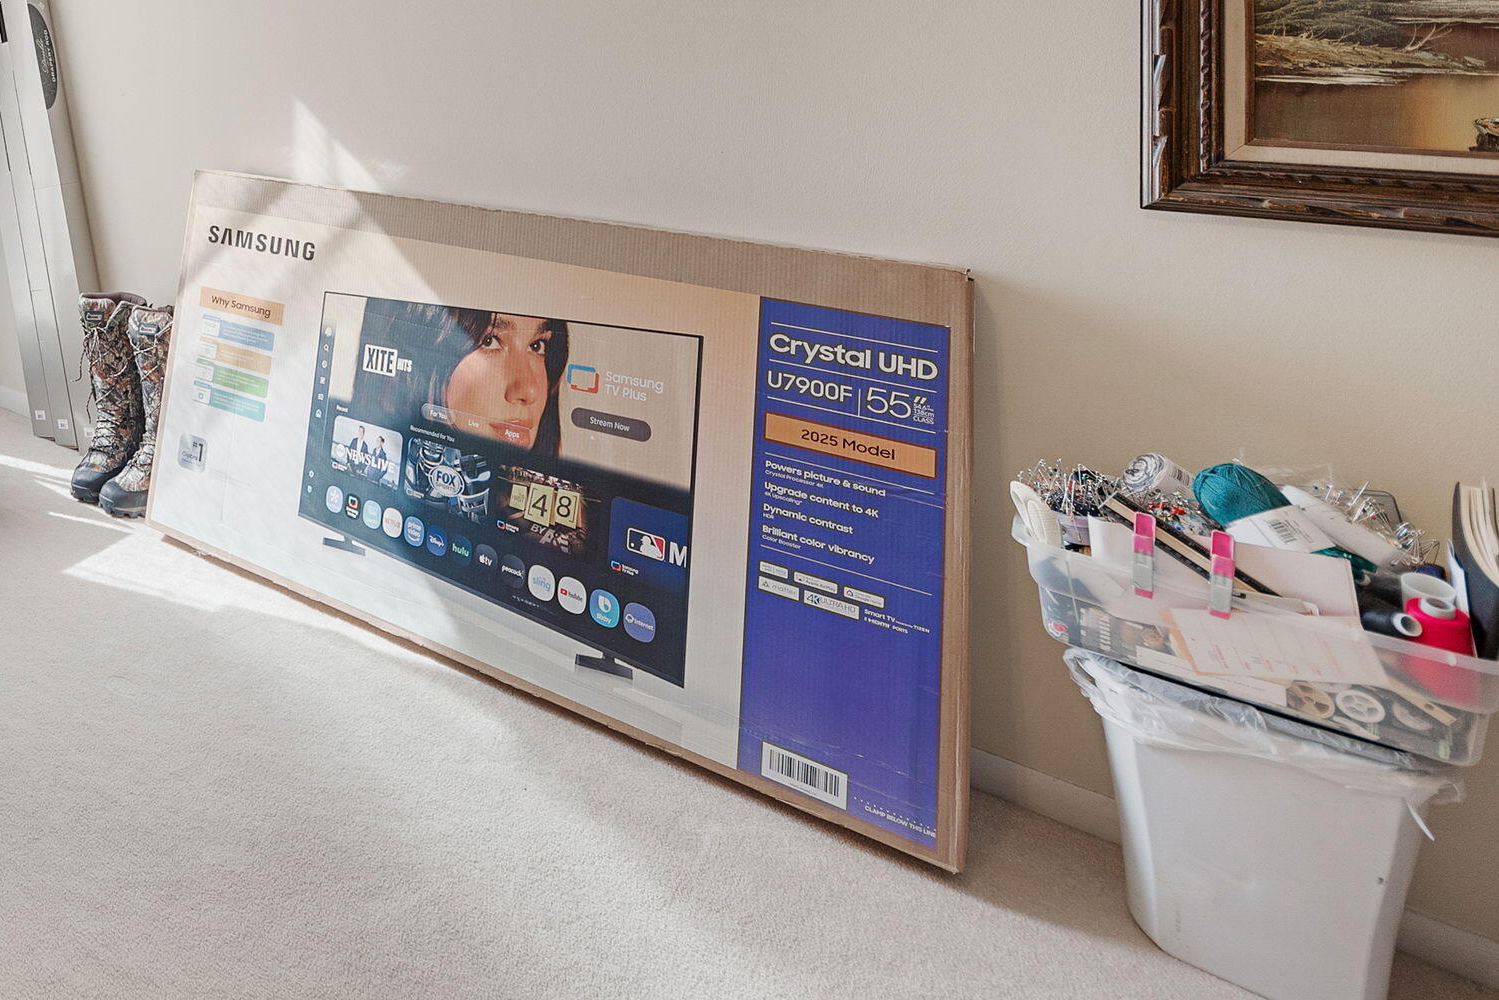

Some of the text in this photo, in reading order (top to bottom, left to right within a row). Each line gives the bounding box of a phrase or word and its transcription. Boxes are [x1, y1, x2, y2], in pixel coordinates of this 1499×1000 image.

[47, 47, 56, 83] DRAPERY
[208, 225, 316, 261] SAMSUNG
[211, 295, 271, 319] Why Samsung
[366, 347, 395, 374] XITE
[769, 333, 938, 380] Crystal UHD
[604, 383, 647, 402] TV Plus
[605, 371, 665, 394] Samsung
[767, 370, 853, 402] U7900F
[468, 419, 480, 428] Live
[504, 428, 520, 440] Apps
[589, 415, 631, 433] Stream Now
[801, 428, 895, 461] 2025 Model
[435, 470, 456, 488] FOX
[764, 469, 787, 480] Crystal
[765, 460, 886, 498] Powers picture & sound
[764, 481, 879, 519] Upgrade content to 4K
[763, 503, 854, 535] Dynamic contrast
[452, 543, 470, 558] hulu
[762, 534, 779, 545] Color
[762, 524, 876, 565] Brilliant color vibrancy
[531, 577, 552, 593] sling
[771, 583, 798, 596] matter
[806, 593, 820, 605] 4K
[634, 617, 655, 631] Internet
[864, 608, 886, 621] Smart
[886, 615, 896, 623] TV
[864, 805, 937, 839] CLAMP BELOW THIS LINE
